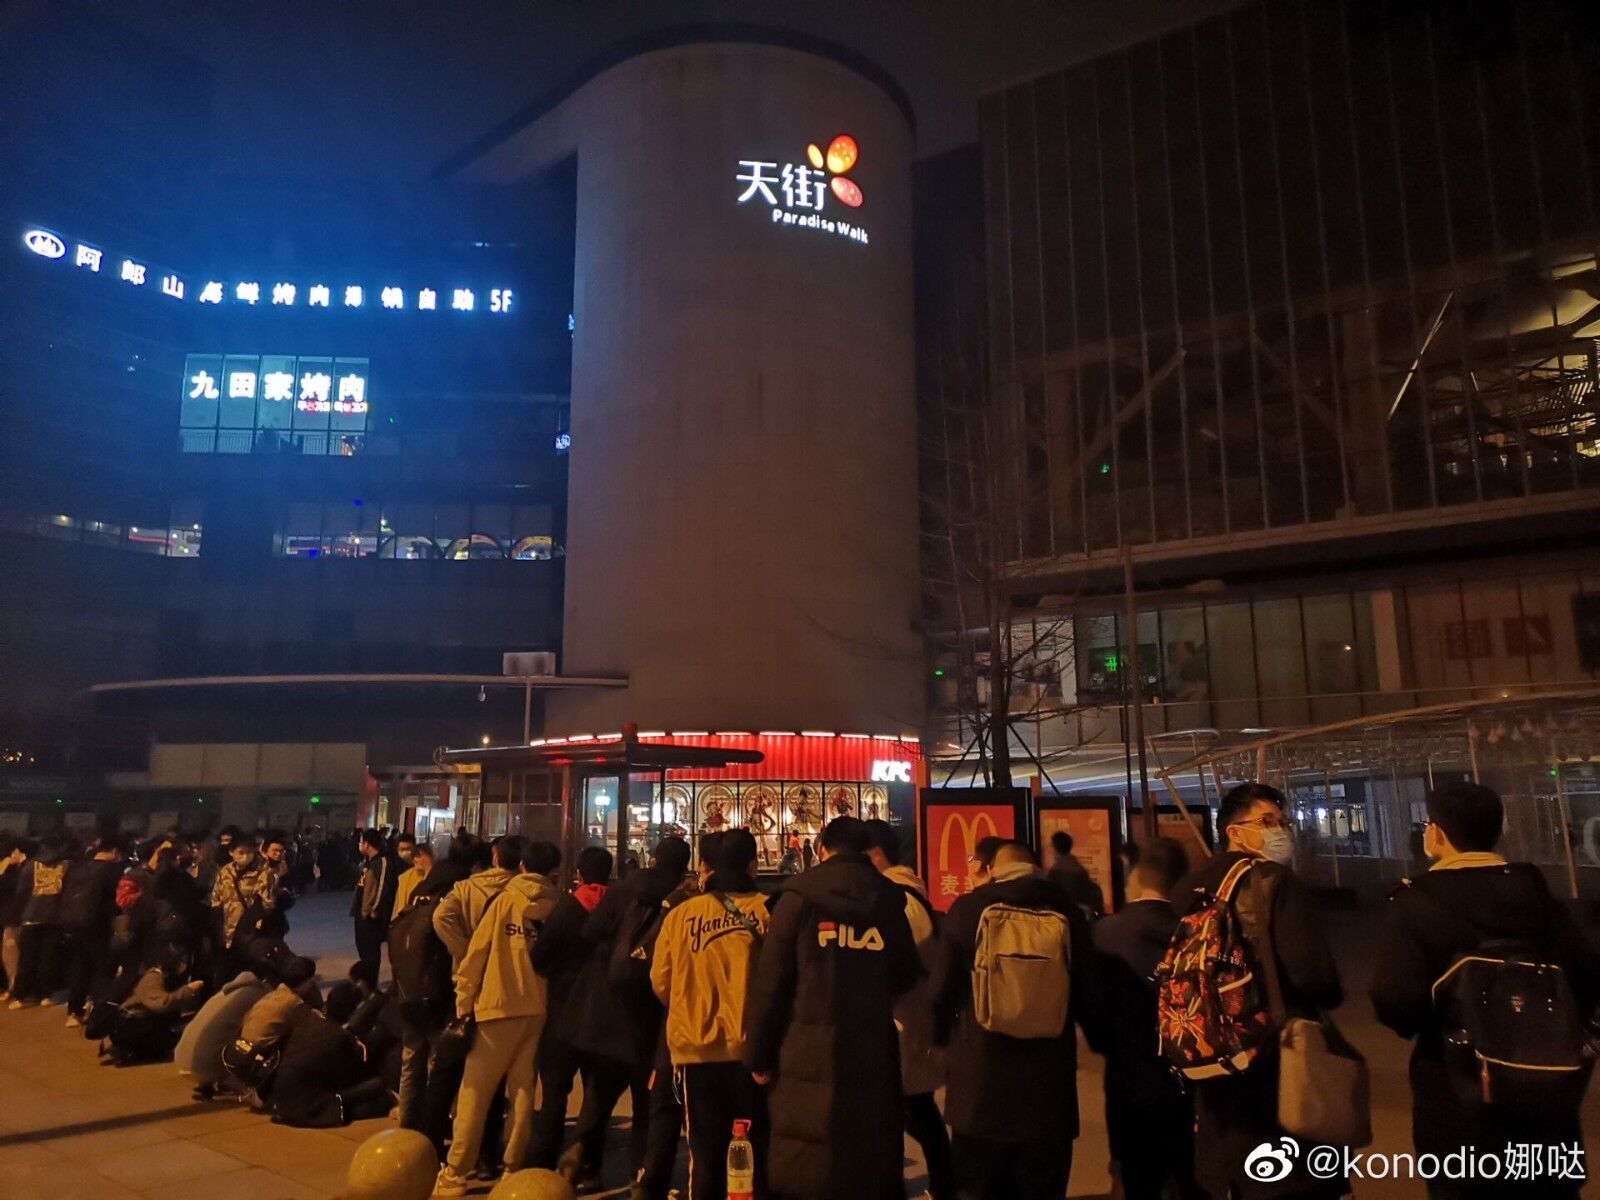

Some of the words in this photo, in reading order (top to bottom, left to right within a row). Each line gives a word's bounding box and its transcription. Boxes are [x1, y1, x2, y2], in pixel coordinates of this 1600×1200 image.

[735, 160, 827, 211] 天街
[772, 208, 835, 233] Paradise
[837, 221, 869, 244] Walk
[490, 288, 512, 313] 5F
[188, 370, 365, 402] 九田家烤肉
[871, 760, 911, 782] KFC
[818, 921, 885, 951] FILA
